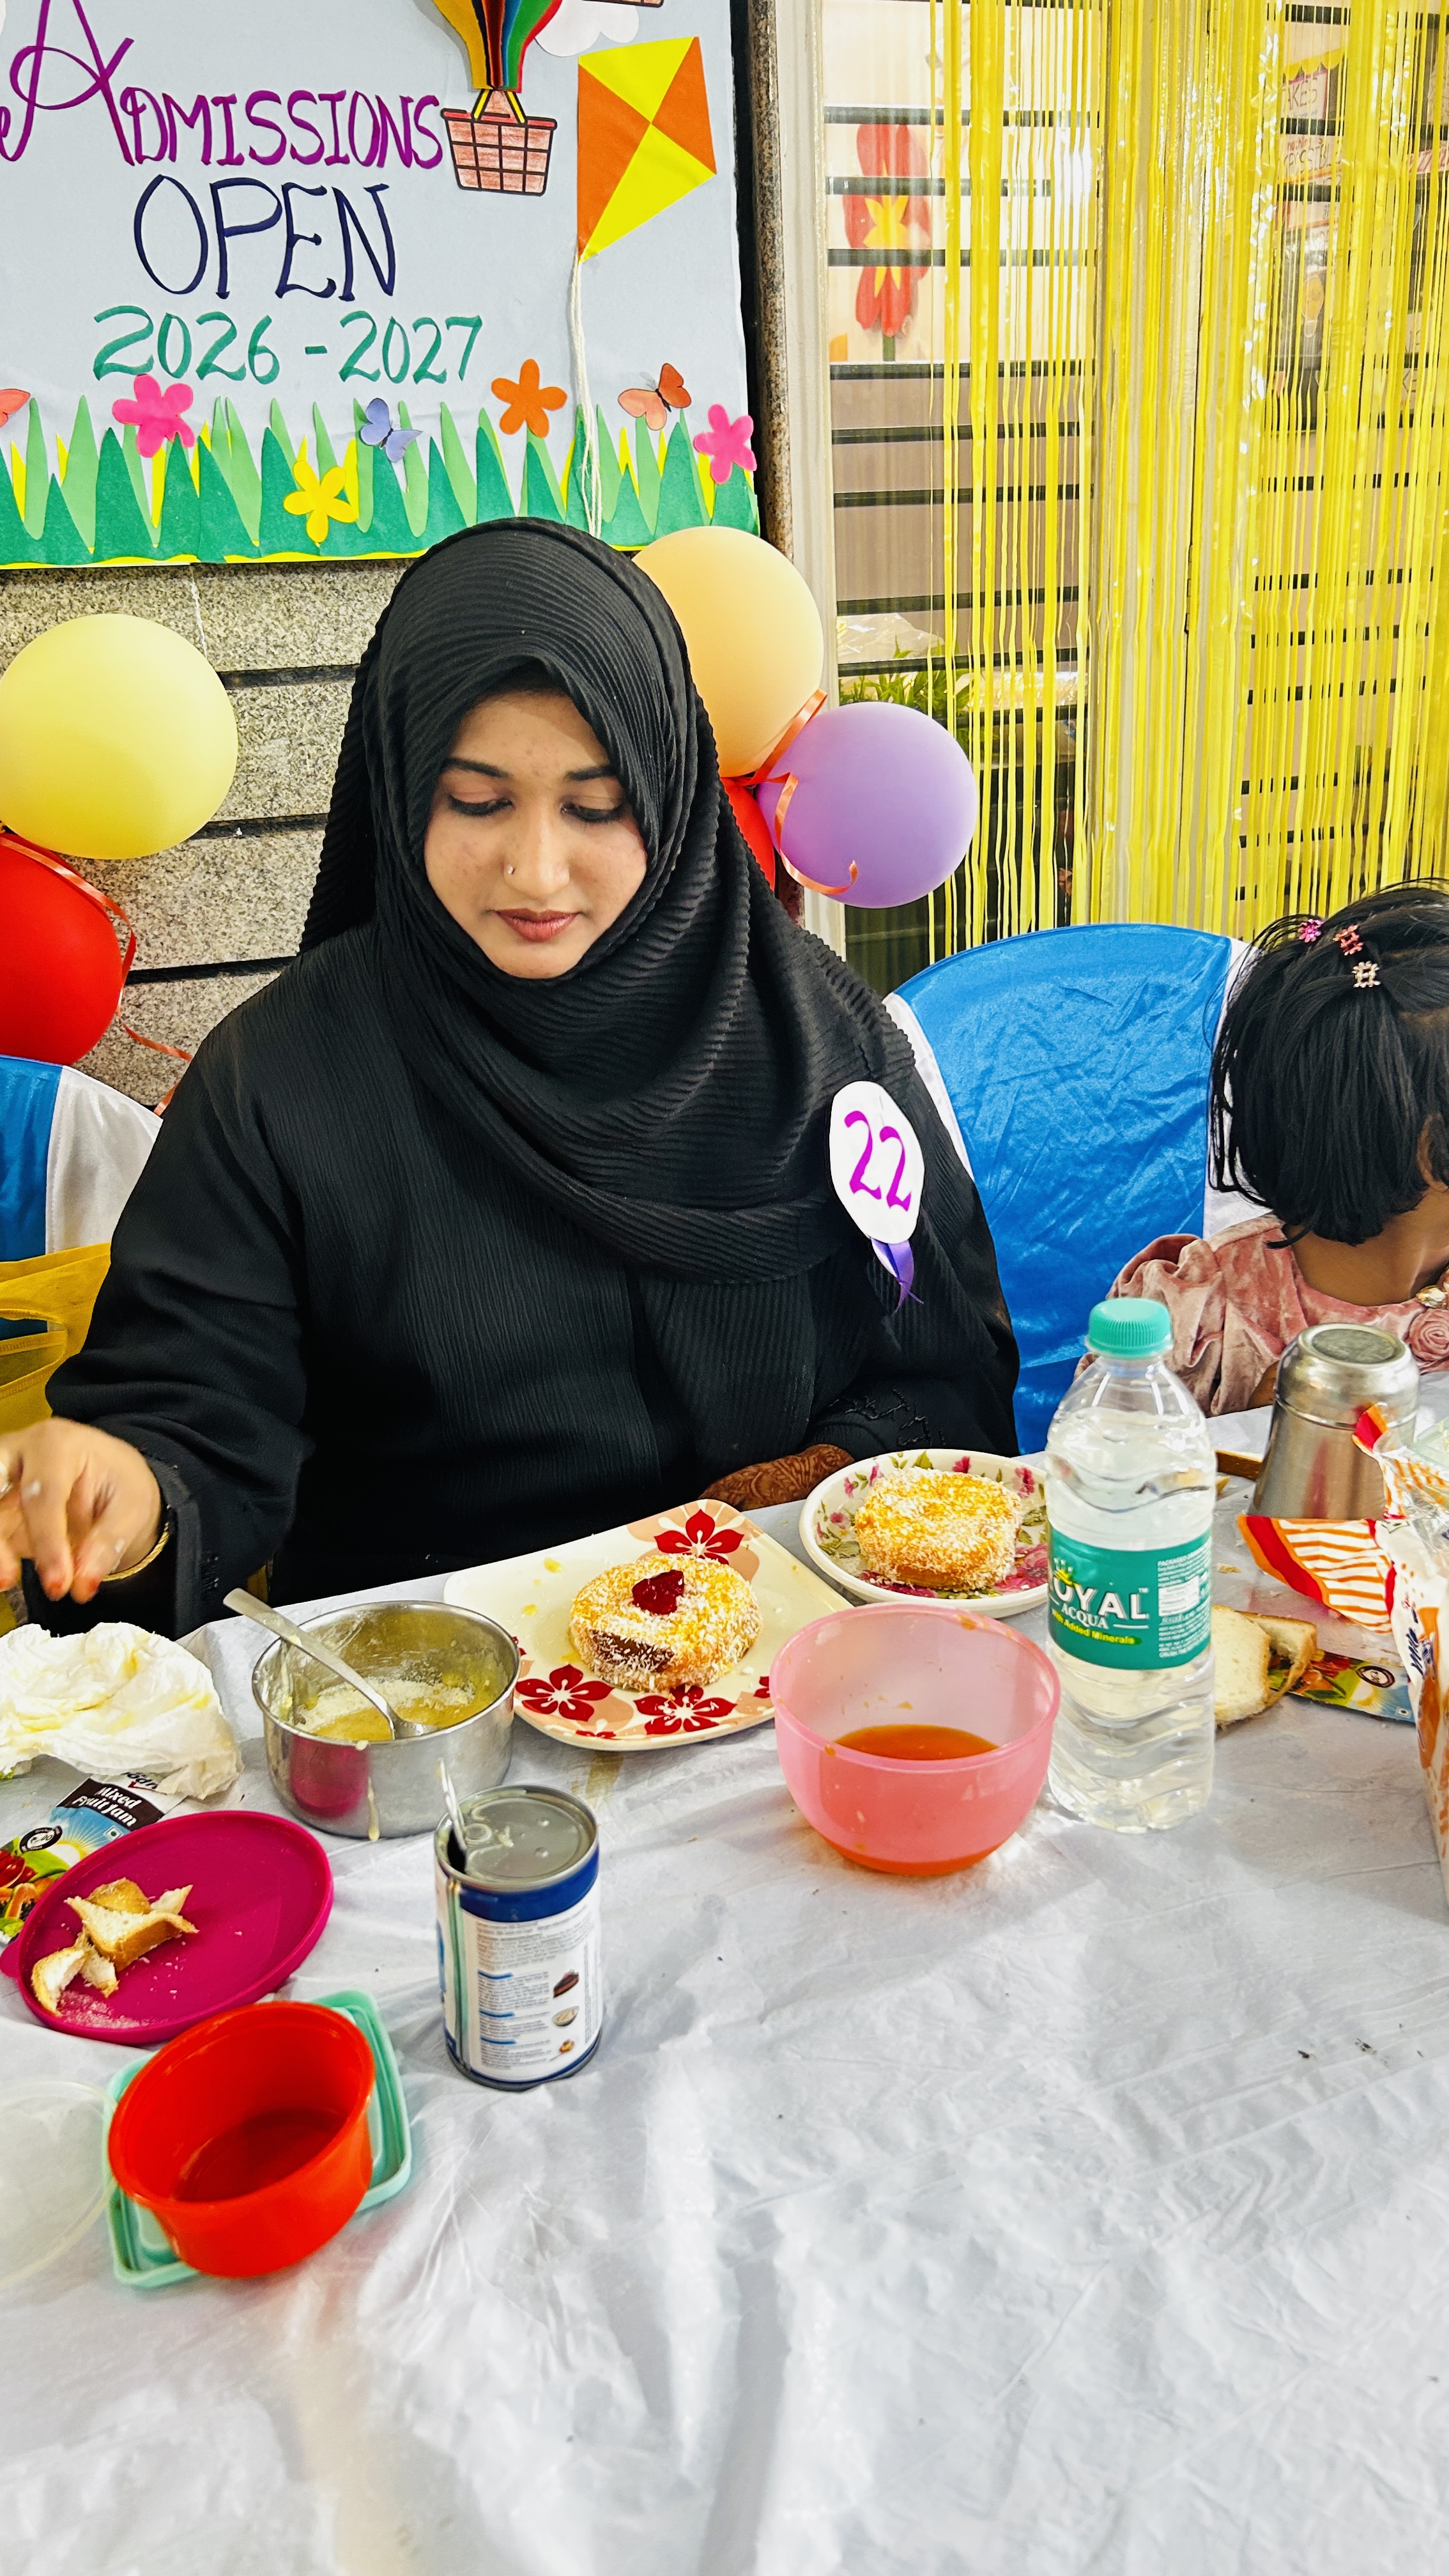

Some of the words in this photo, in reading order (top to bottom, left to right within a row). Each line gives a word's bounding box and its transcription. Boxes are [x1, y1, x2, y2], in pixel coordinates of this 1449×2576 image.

[0, 0, 443, 168] ADMISSIONS
[134, 174, 397, 301] OPEN
[93, 305, 280, 384] 2026
[338, 311, 482, 383] 2027
[844, 1110, 912, 1212] 22
[1061, 1602, 1109, 1630] ACQUA
[1064, 1618, 1091, 1637] Added
[1091, 1630, 1135, 1645] Minerals
[72, 1795, 110, 1809] Fruit
[100, 1804, 137, 1826] Jam
[95, 1787, 142, 1809] Mixed
